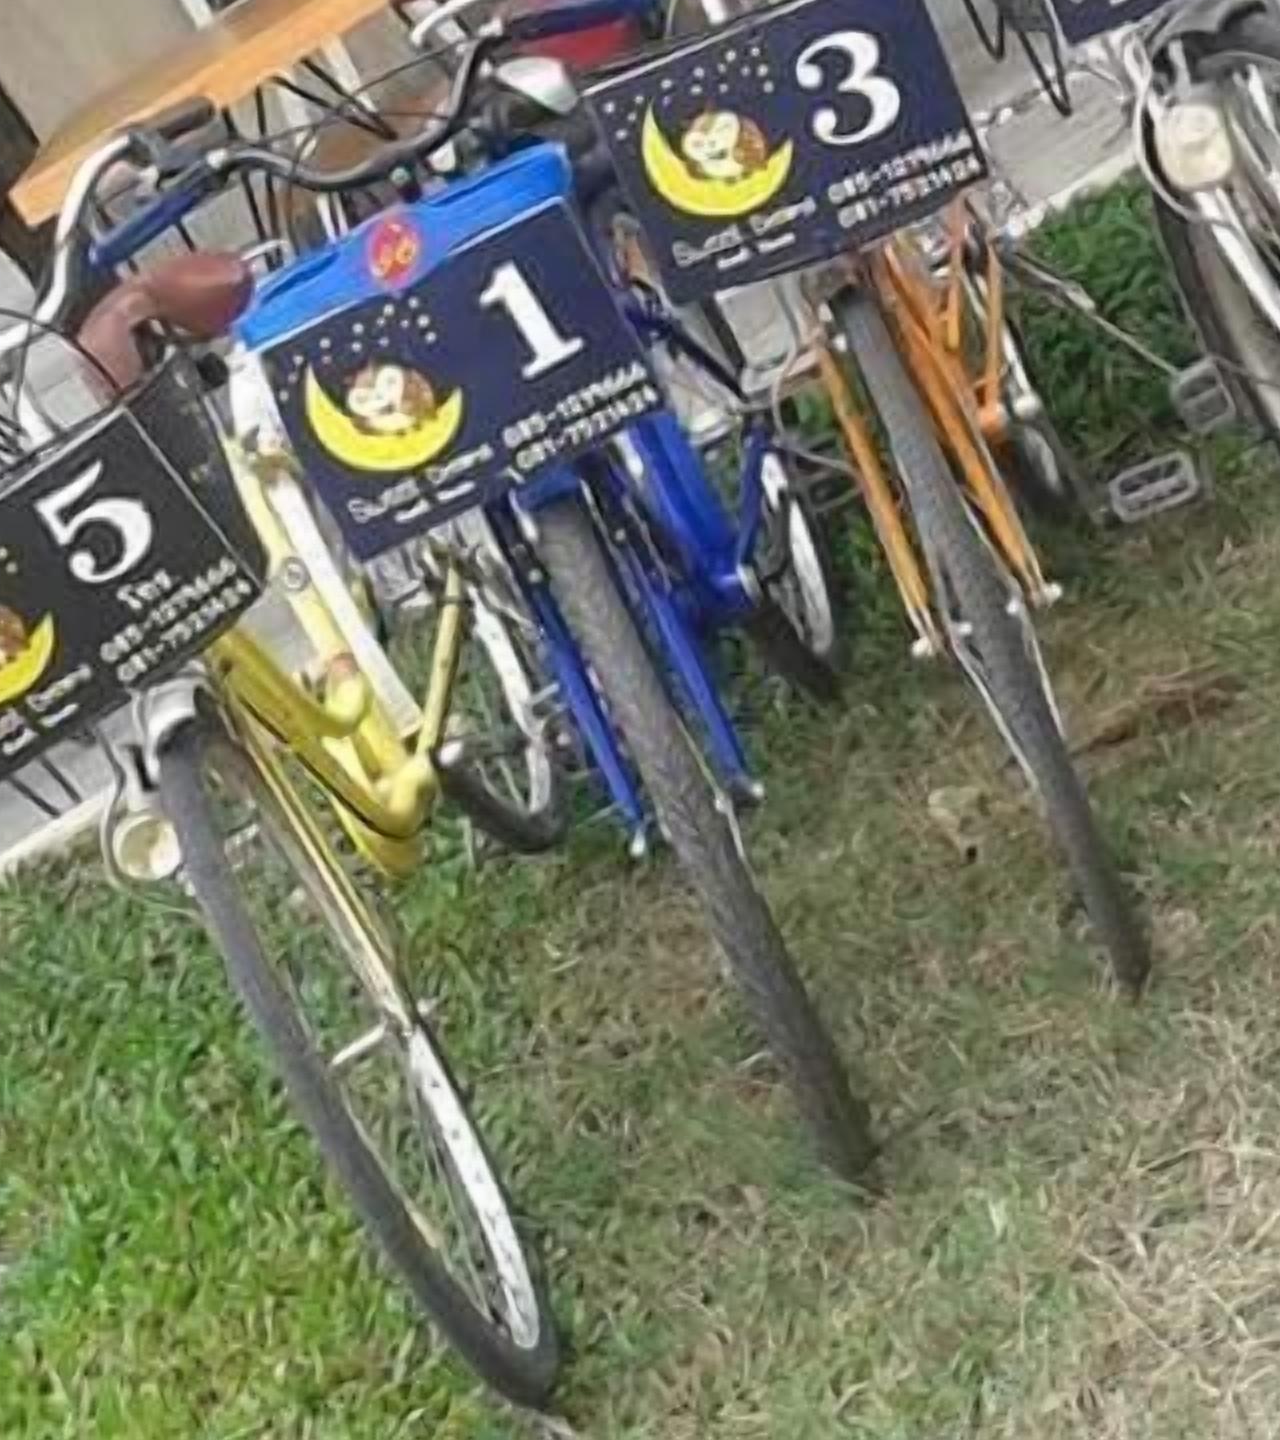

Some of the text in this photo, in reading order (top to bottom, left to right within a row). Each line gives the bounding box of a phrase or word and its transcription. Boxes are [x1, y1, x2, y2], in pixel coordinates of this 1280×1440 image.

[796, 31, 900, 145] 3
[480, 262, 585, 380] 1
[34, 460, 153, 583] 5
